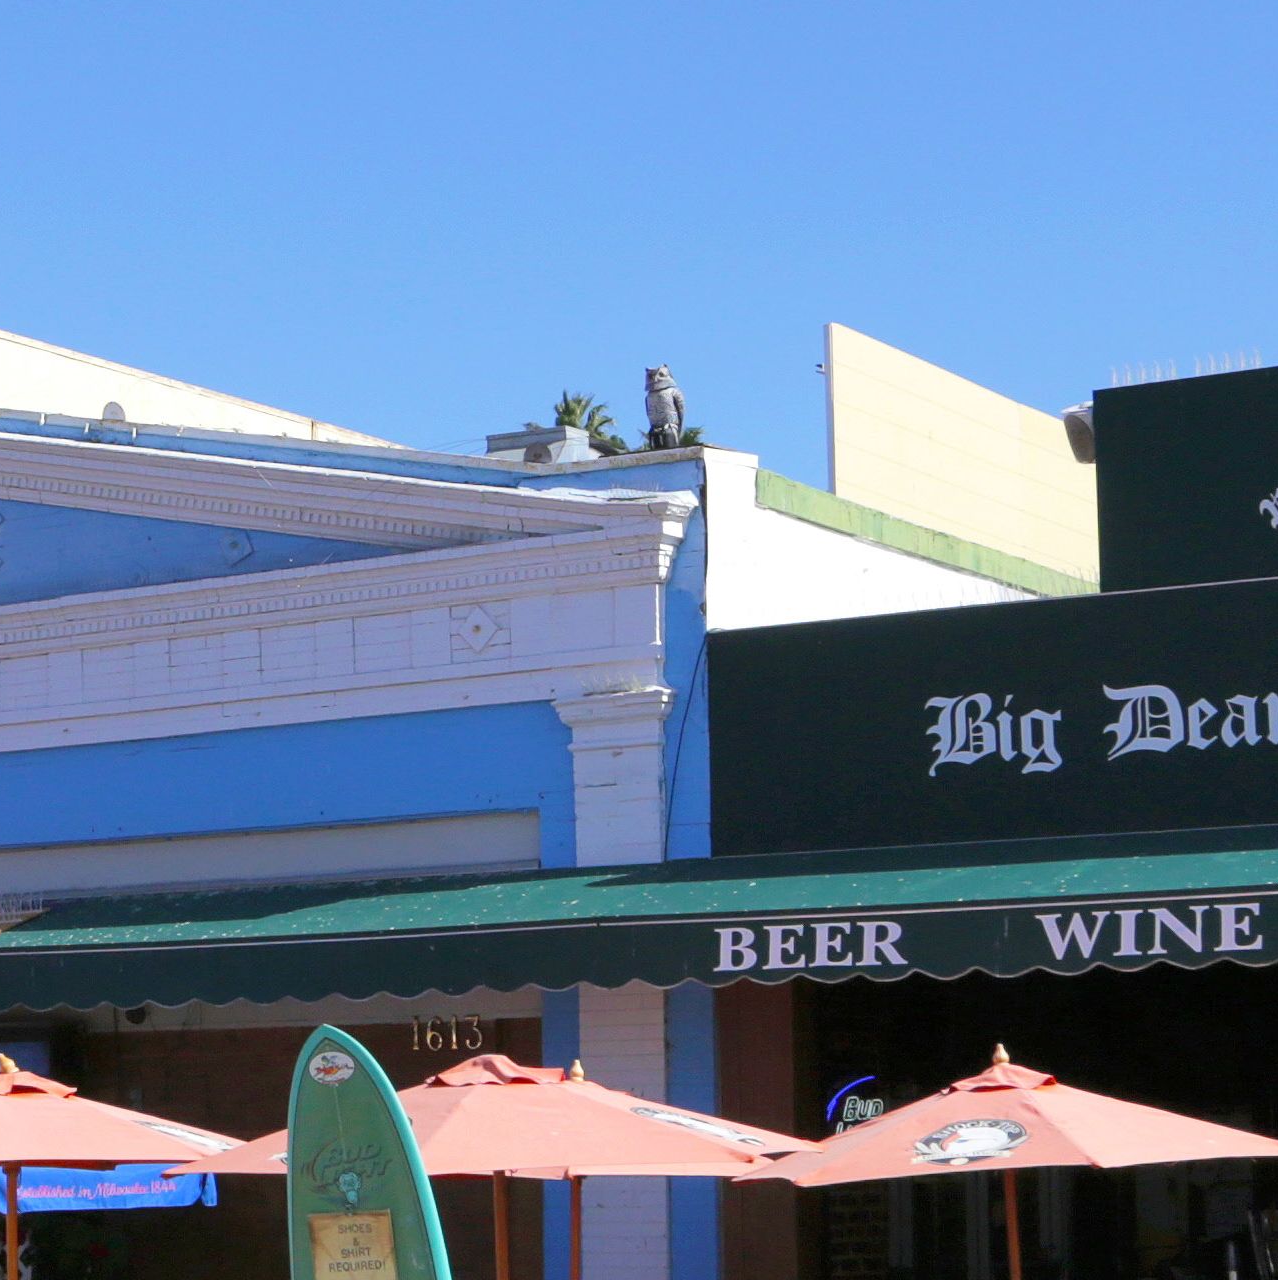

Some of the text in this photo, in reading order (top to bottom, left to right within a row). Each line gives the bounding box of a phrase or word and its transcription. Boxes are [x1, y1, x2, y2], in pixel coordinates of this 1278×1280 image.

[925, 693, 1062, 776] Big
[714, 922, 908, 971] BEER
[1035, 903, 1262, 960] WINE
[412, 1015, 483, 1051] 1613
[337, 1223, 373, 1234] SHOES
[353, 1237, 360, 1246] &
[341, 1247, 371, 1258] SHIRT
[328, 1259, 386, 1272] REQUIRED!
